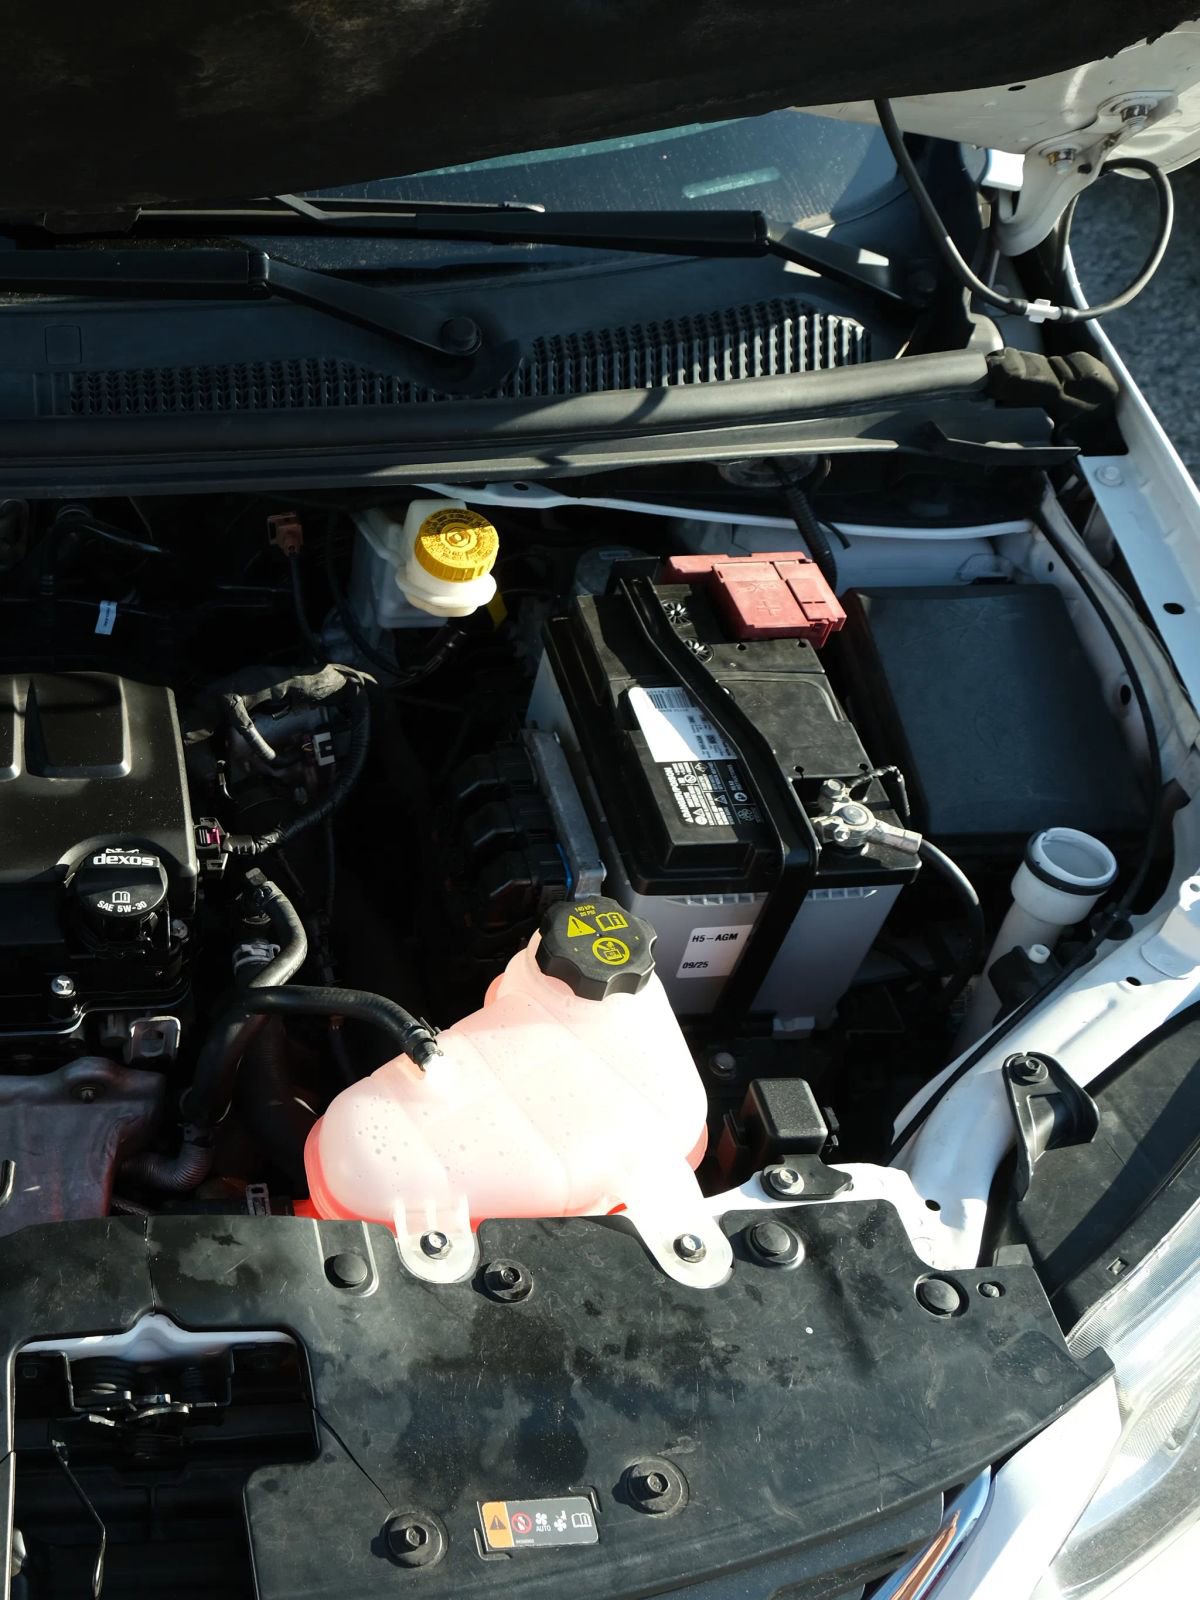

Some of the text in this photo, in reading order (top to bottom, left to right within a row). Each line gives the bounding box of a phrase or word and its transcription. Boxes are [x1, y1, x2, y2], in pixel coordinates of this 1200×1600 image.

[93, 853, 155, 866] dexos
[97, 900, 148, 913] SAE 5W-30
[682, 960, 709, 970] 09/25
